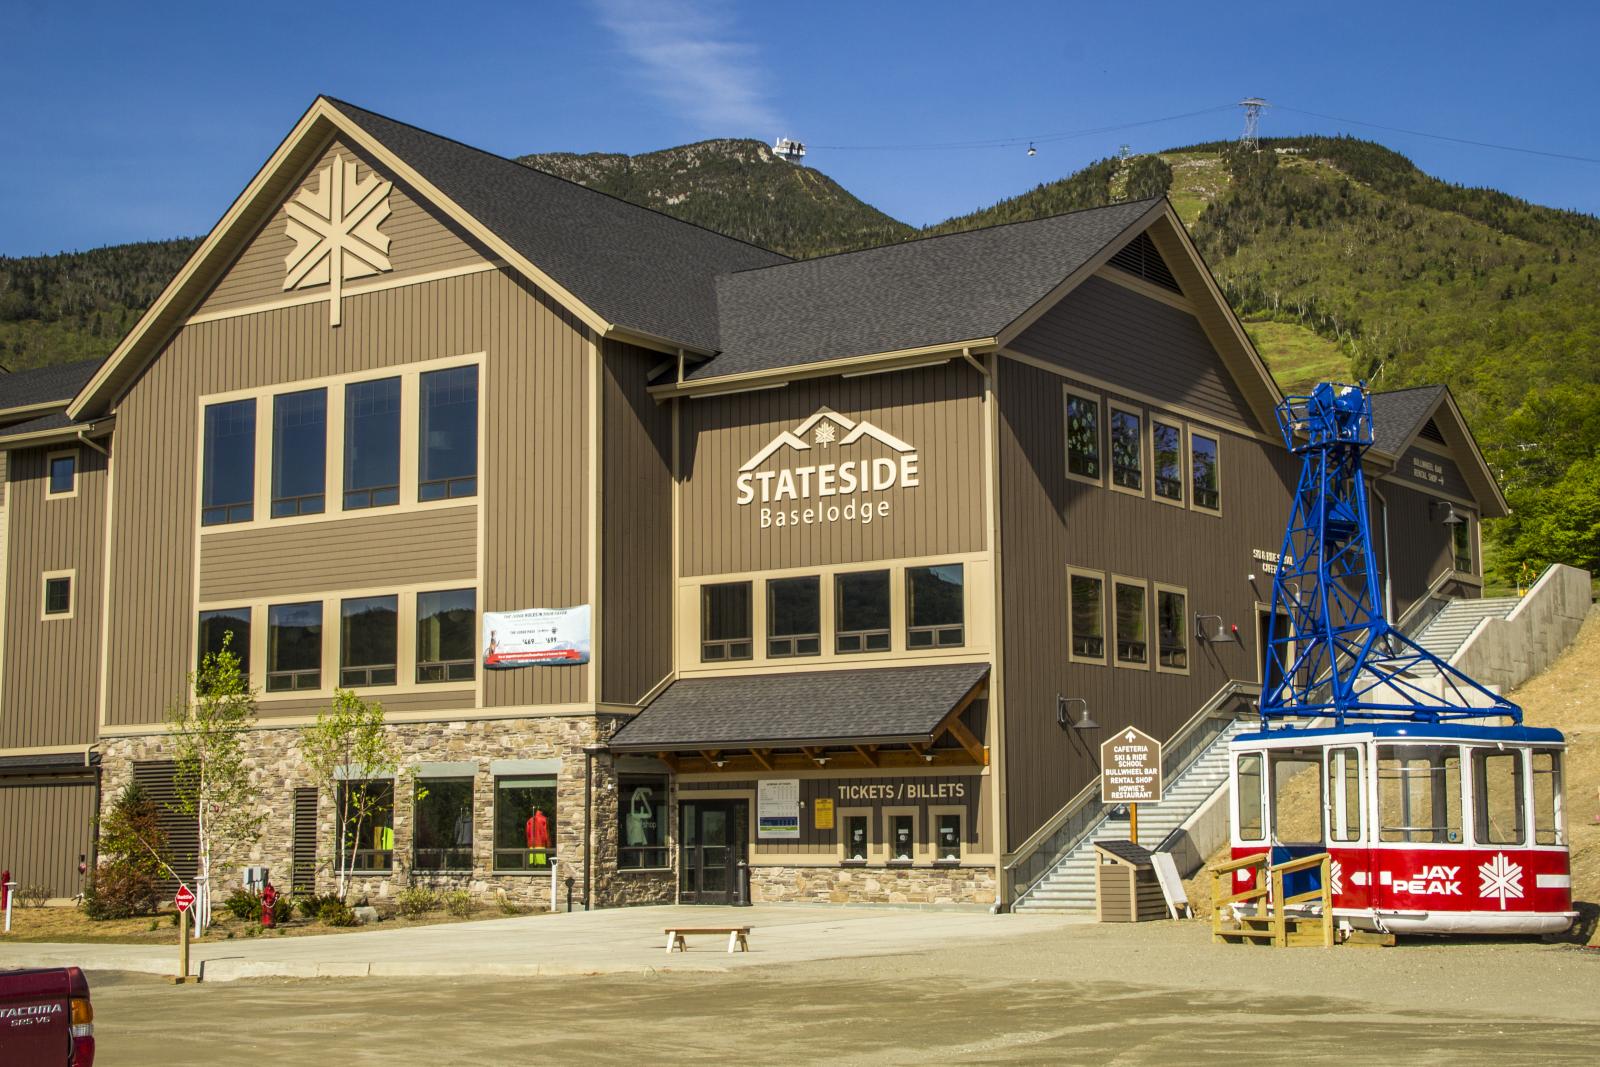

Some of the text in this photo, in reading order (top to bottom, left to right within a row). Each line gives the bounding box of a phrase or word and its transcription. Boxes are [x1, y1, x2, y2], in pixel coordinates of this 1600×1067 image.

[736, 454, 920, 505] STATESIDE
[760, 498, 890, 529] Baselodge
[838, 784, 894, 800] TICKETS
[907, 783, 965, 799] BILLETS
[1412, 866, 1461, 880] JAY
[1392, 880, 1463, 896] PEAK
[0, 1004, 62, 1018] TACOMA
